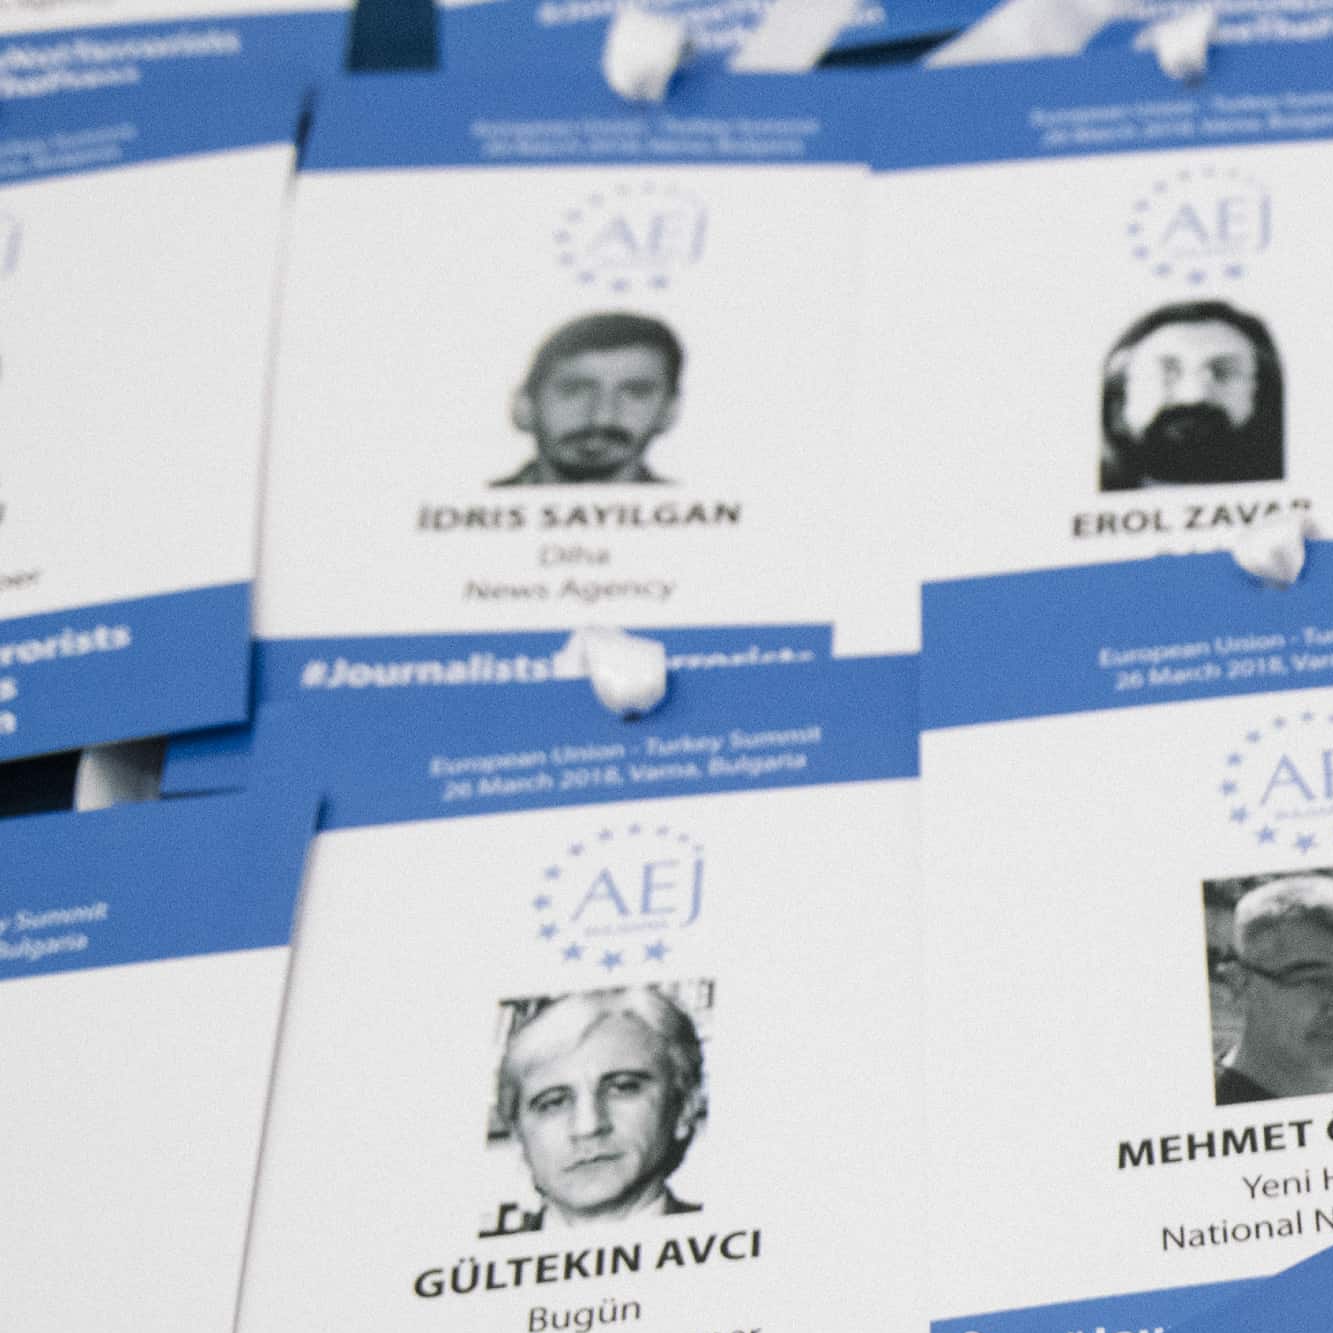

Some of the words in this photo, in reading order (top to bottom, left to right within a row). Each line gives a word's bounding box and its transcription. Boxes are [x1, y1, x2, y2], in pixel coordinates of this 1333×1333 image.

[542, 500, 742, 528] SAYILGAN
[1073, 508, 1167, 538] EROL
[1099, 643, 1211, 669] European
[1212, 635, 1286, 657] Union
[1113, 669, 1145, 690] 26
[1147, 662, 1223, 687] March
[429, 751, 548, 776] European
[549, 742, 626, 765] Union
[644, 732, 722, 755] Turkey
[725, 722, 821, 749] Summit
[442, 779, 475, 801] 26
[477, 771, 556, 797] March
[707, 749, 806, 775] Bulgaria
[571, 857, 705, 930] AEJ
[1118, 1119, 1312, 1169] MEHMET
[1243, 1170, 1310, 1199] Yeni
[1162, 1210, 1302, 1251] National
[414, 1244, 640, 1298] GÜLTEKIN
[656, 1230, 760, 1269] AVCI
[528, 1301, 640, 1333] Bugün
